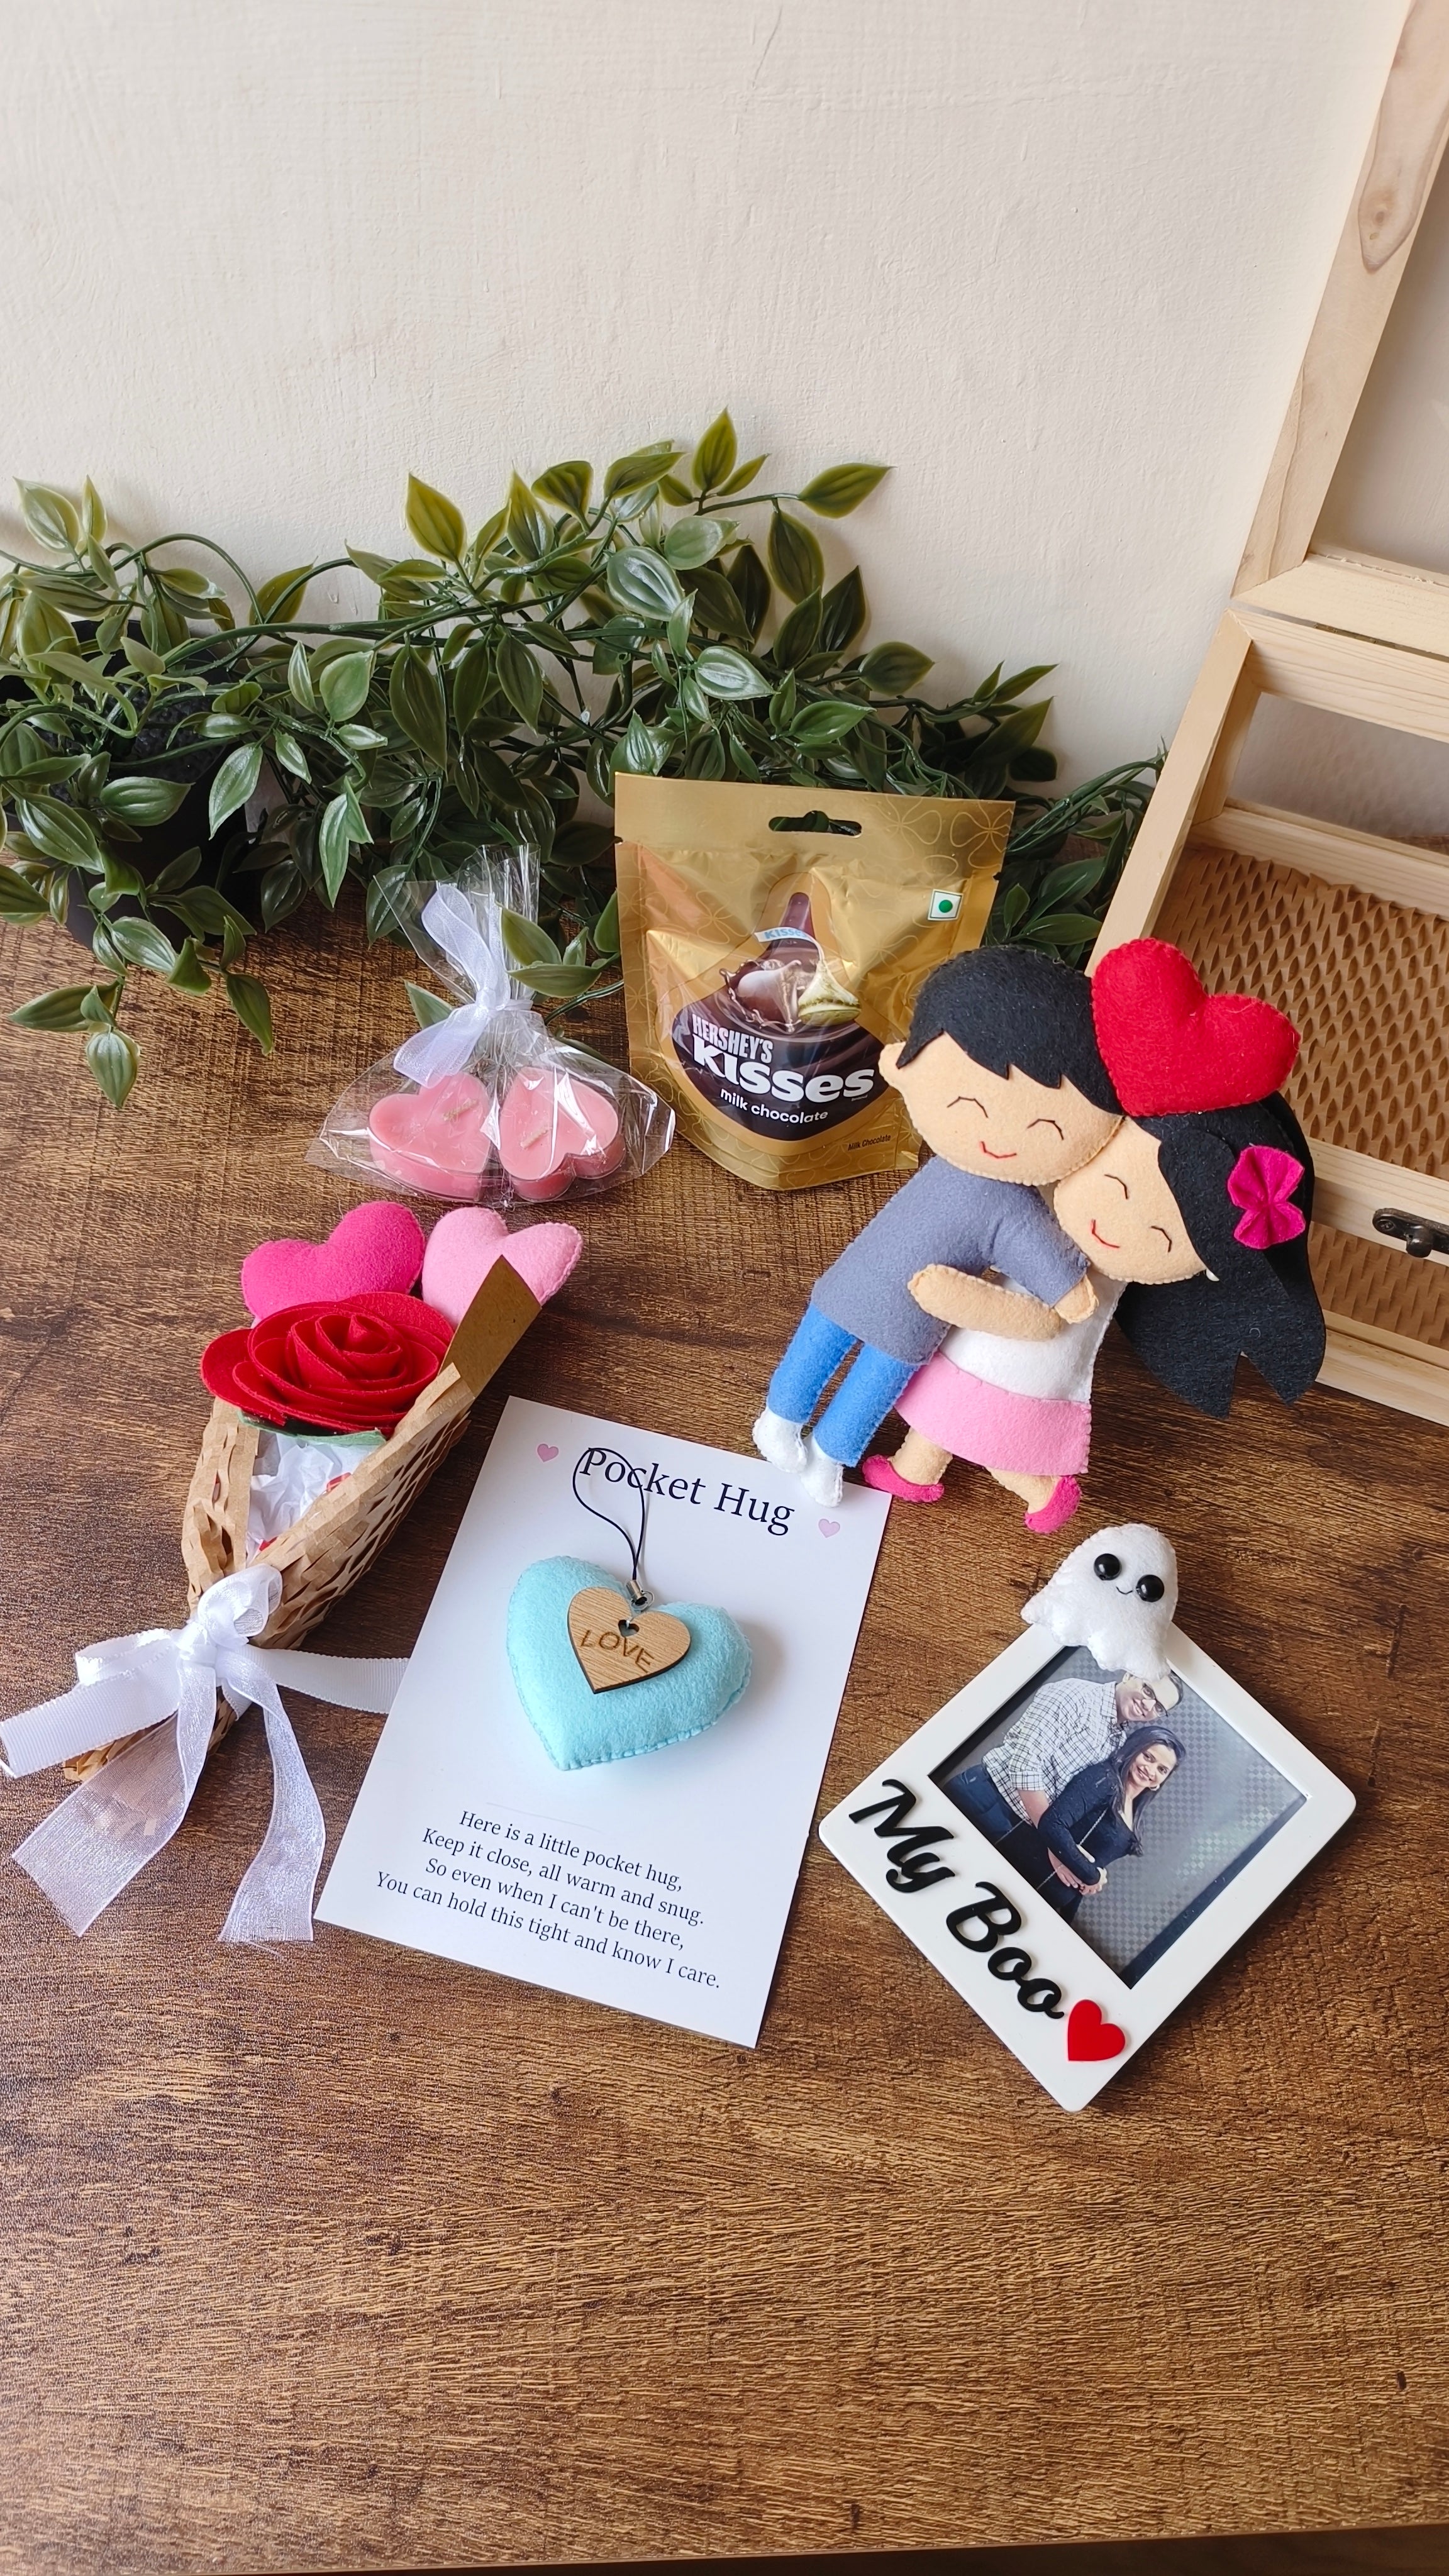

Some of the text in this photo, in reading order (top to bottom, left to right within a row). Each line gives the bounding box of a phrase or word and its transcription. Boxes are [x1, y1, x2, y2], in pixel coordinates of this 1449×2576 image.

[692, 1014, 774, 1063] HERSHEY'S
[720, 1089, 828, 1124] milk chocolate
[848, 1134, 891, 1151] Milk Chocolate
[579, 1448, 795, 1536] Pocket Hug
[580, 1629, 655, 1673] LOVE
[421, 1827, 704, 1927] Keep it close, all warm and snug.
[458, 1810, 682, 1892] Here is a little pocket hug,
[377, 1871, 719, 1989] You can hold this tight and know I care.
[425, 1858, 684, 1951] So even when I can't be there,
[848, 1779, 1065, 2019] My Boo
